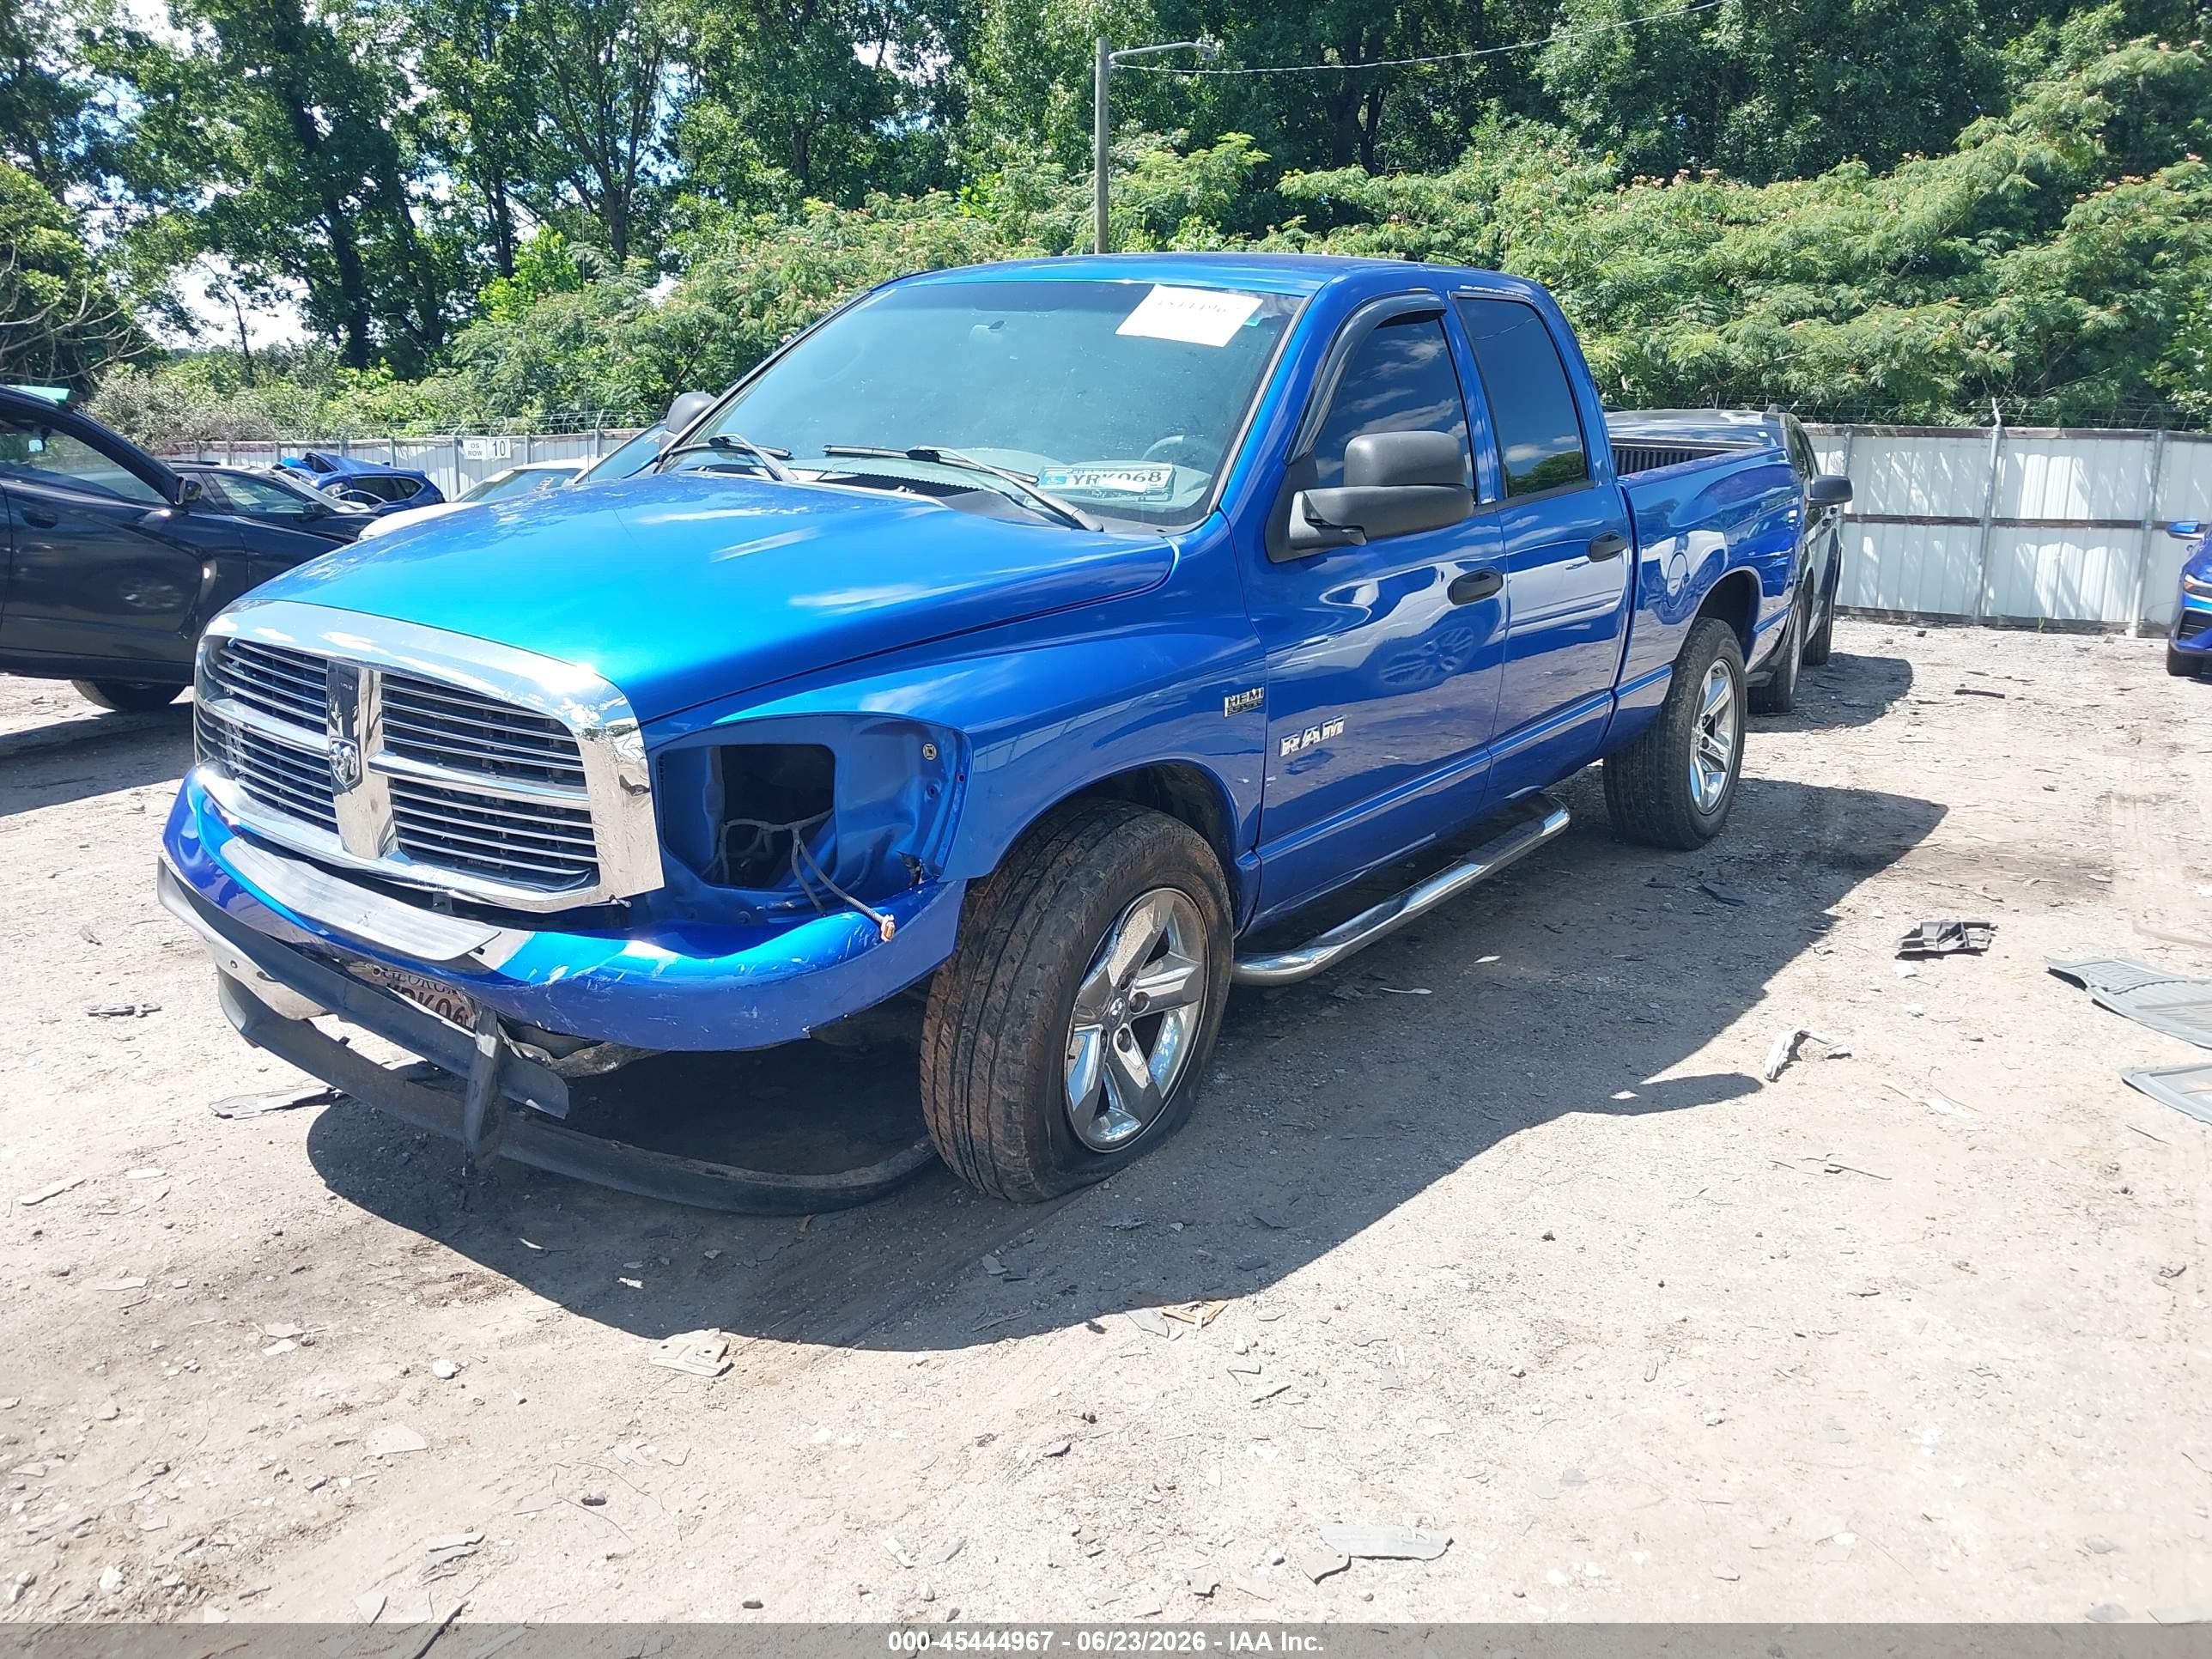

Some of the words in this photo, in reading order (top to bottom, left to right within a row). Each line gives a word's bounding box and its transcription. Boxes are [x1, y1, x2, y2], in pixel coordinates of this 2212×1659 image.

[492, 440, 506, 457] 10
[1227, 688, 1264, 708] HEMI
[1279, 715, 1345, 757] RAM
